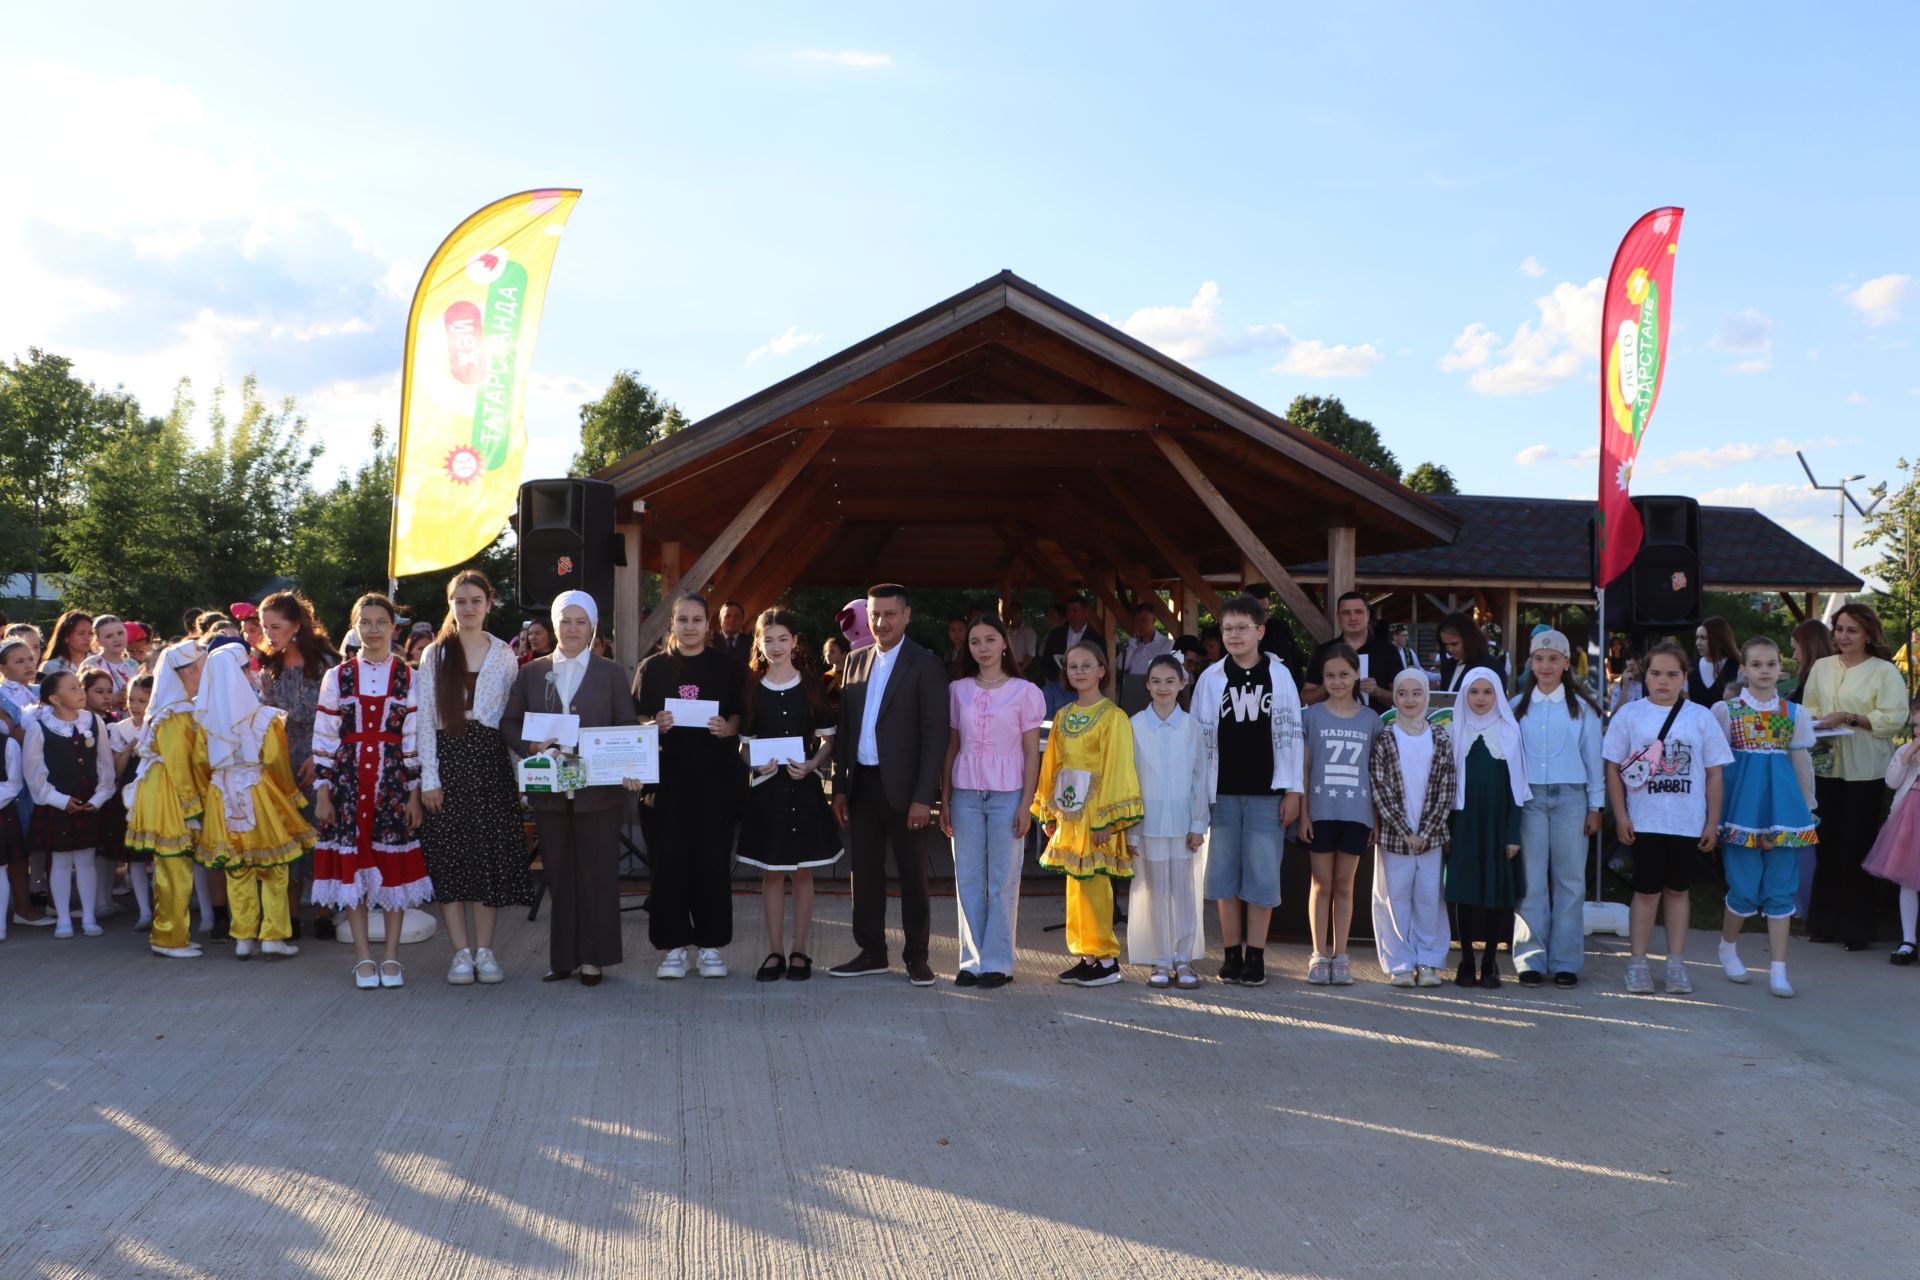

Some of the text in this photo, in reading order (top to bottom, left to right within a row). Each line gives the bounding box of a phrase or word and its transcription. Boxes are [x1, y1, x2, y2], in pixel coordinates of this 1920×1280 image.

[479, 286, 519, 444] ТАТАРСТАНДА
[1623, 334, 1633, 388] ЛЕТО
[1326, 740, 1363, 764] 77
[1648, 779, 1692, 794] RABBIT
